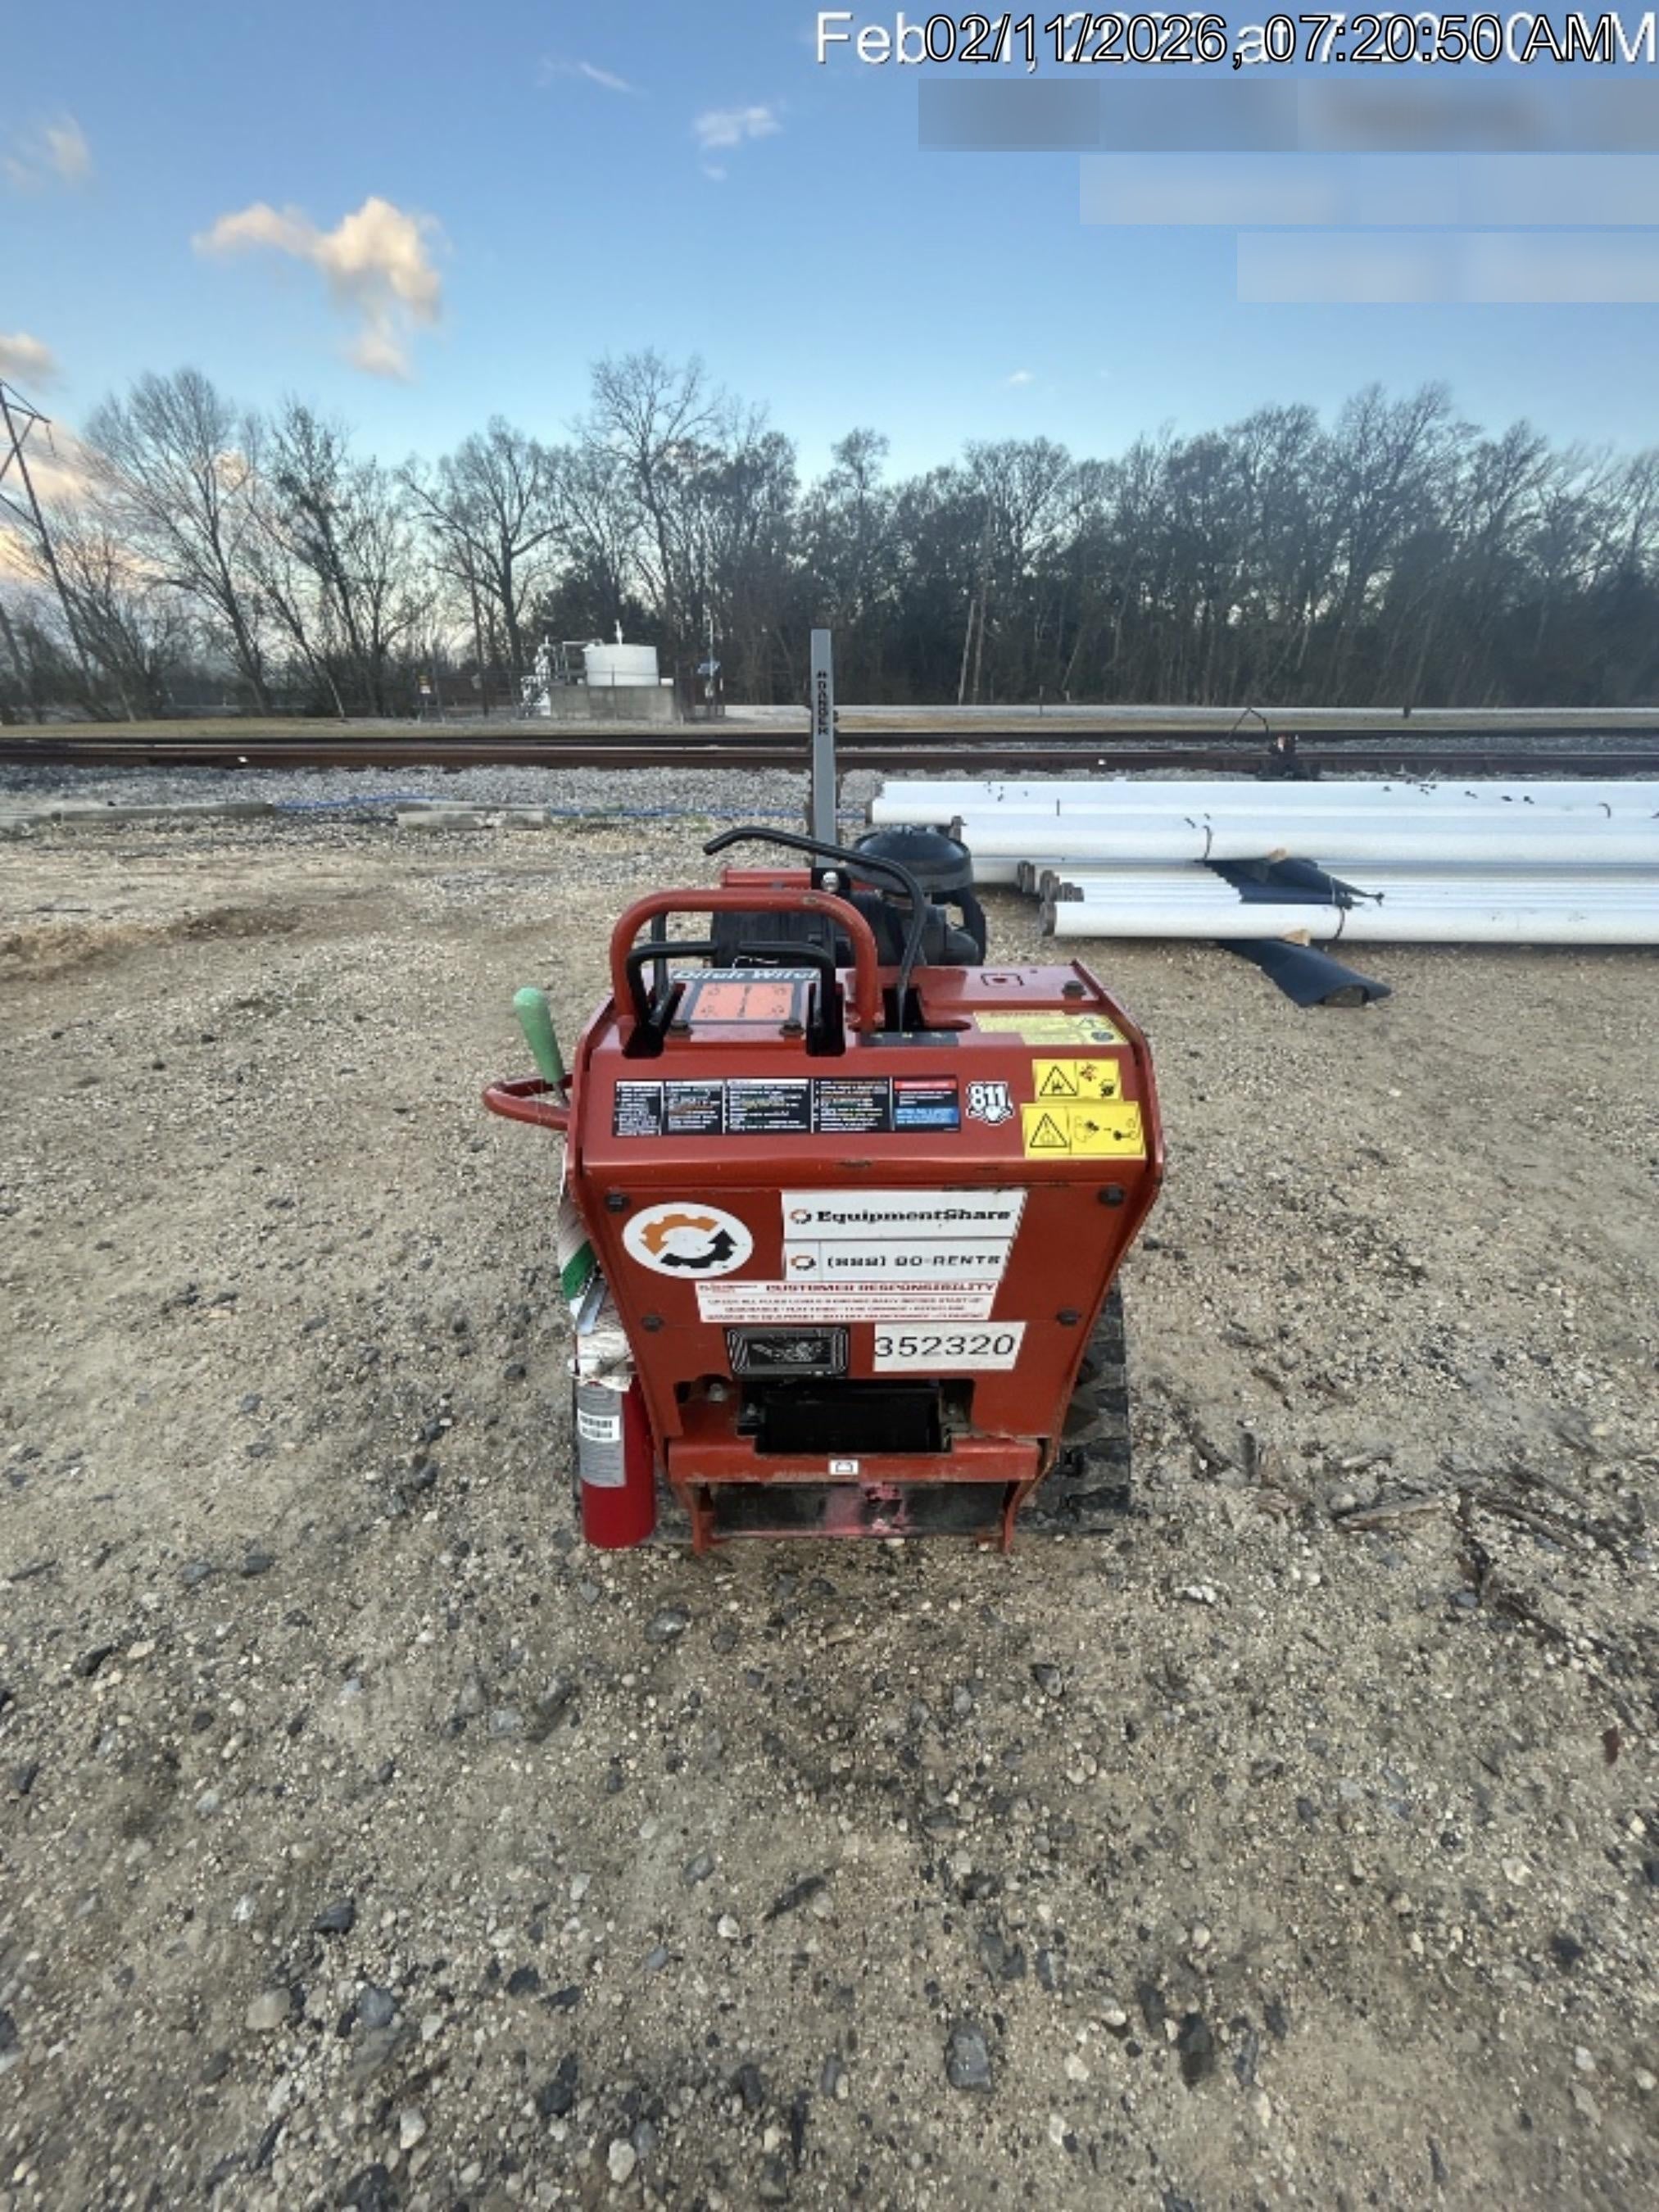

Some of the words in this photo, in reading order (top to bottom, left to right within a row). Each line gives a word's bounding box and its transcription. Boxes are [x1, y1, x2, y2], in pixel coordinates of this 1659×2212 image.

[970, 1085, 1007, 1108] 811
[817, 1208, 1011, 1225] EquipmentShare
[873, 1334, 1016, 1358] 352320
